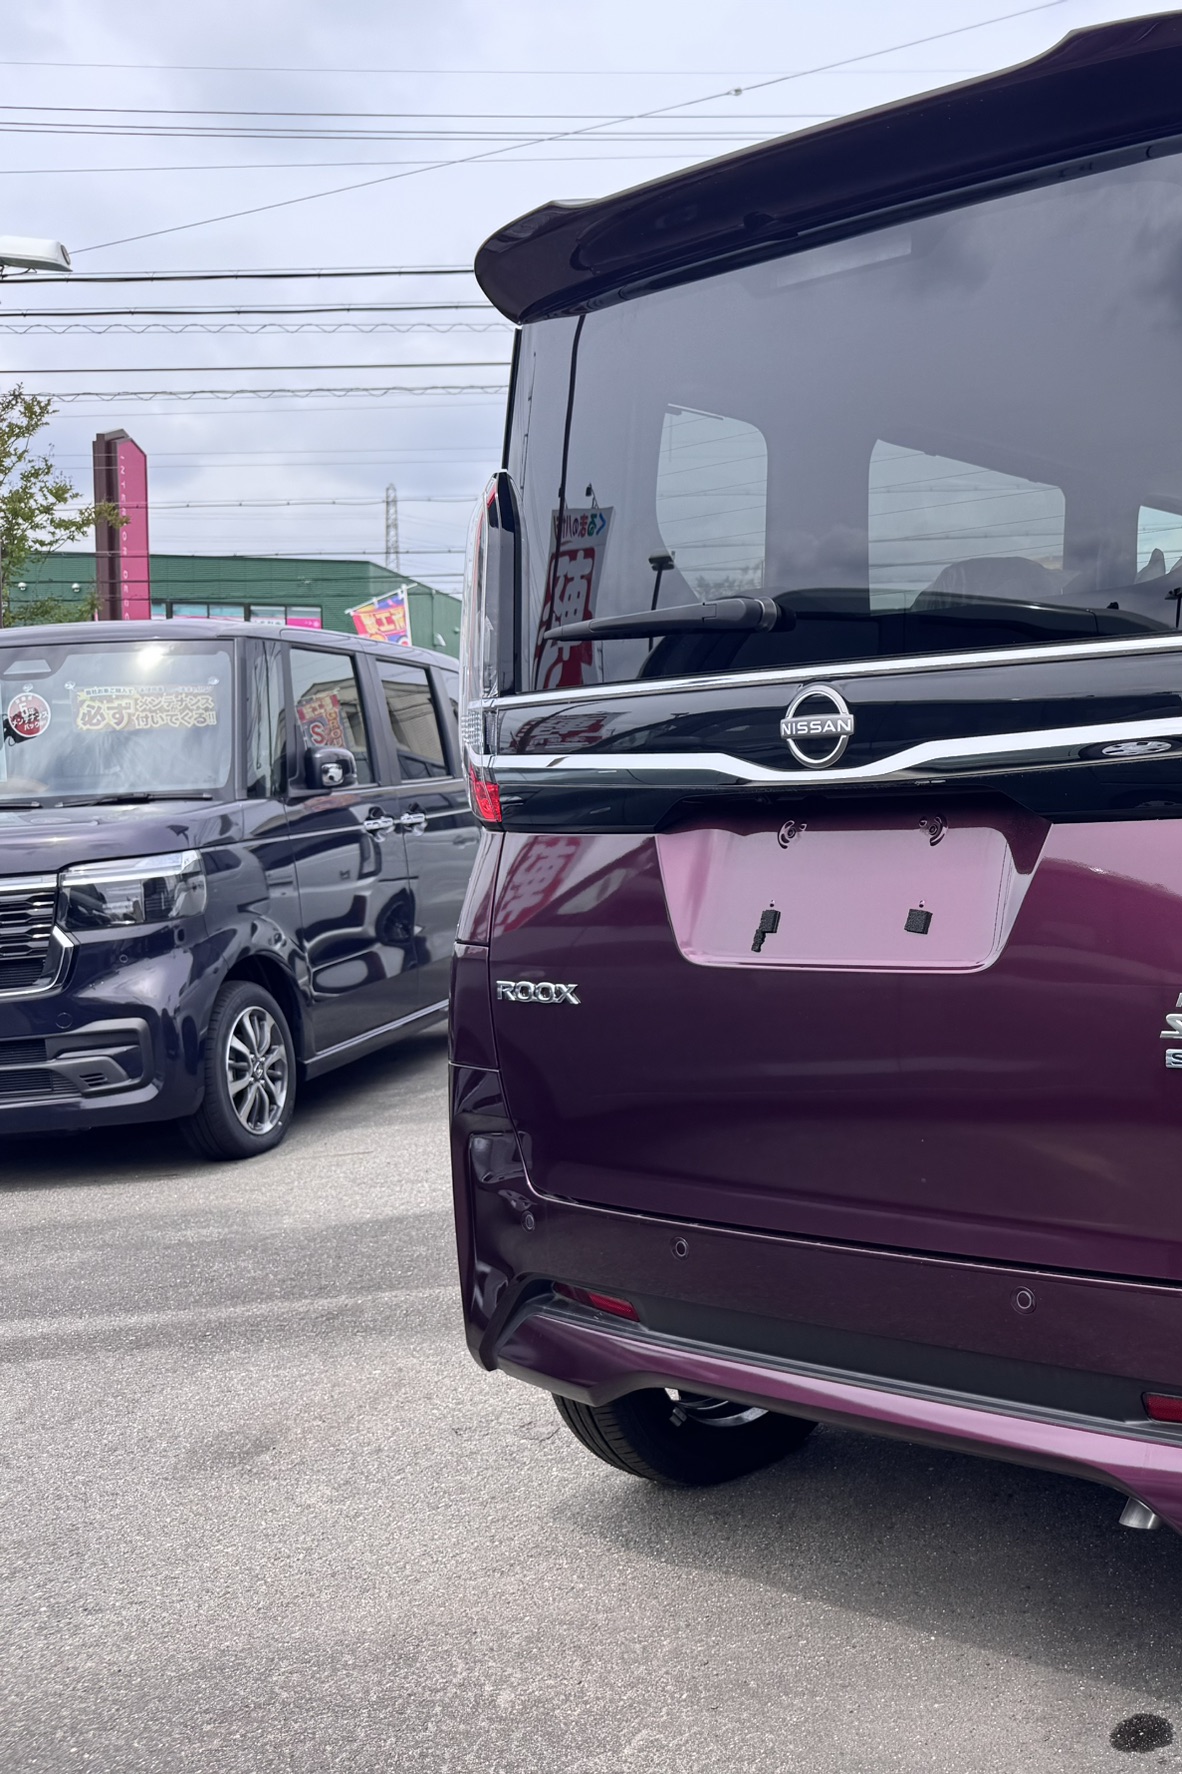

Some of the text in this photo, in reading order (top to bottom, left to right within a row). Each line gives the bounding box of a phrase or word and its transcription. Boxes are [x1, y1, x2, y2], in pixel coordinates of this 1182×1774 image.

[79, 702, 133, 729] 必ず
[781, 719, 851, 735] NISSAN
[496, 980, 581, 1004] ROOX
